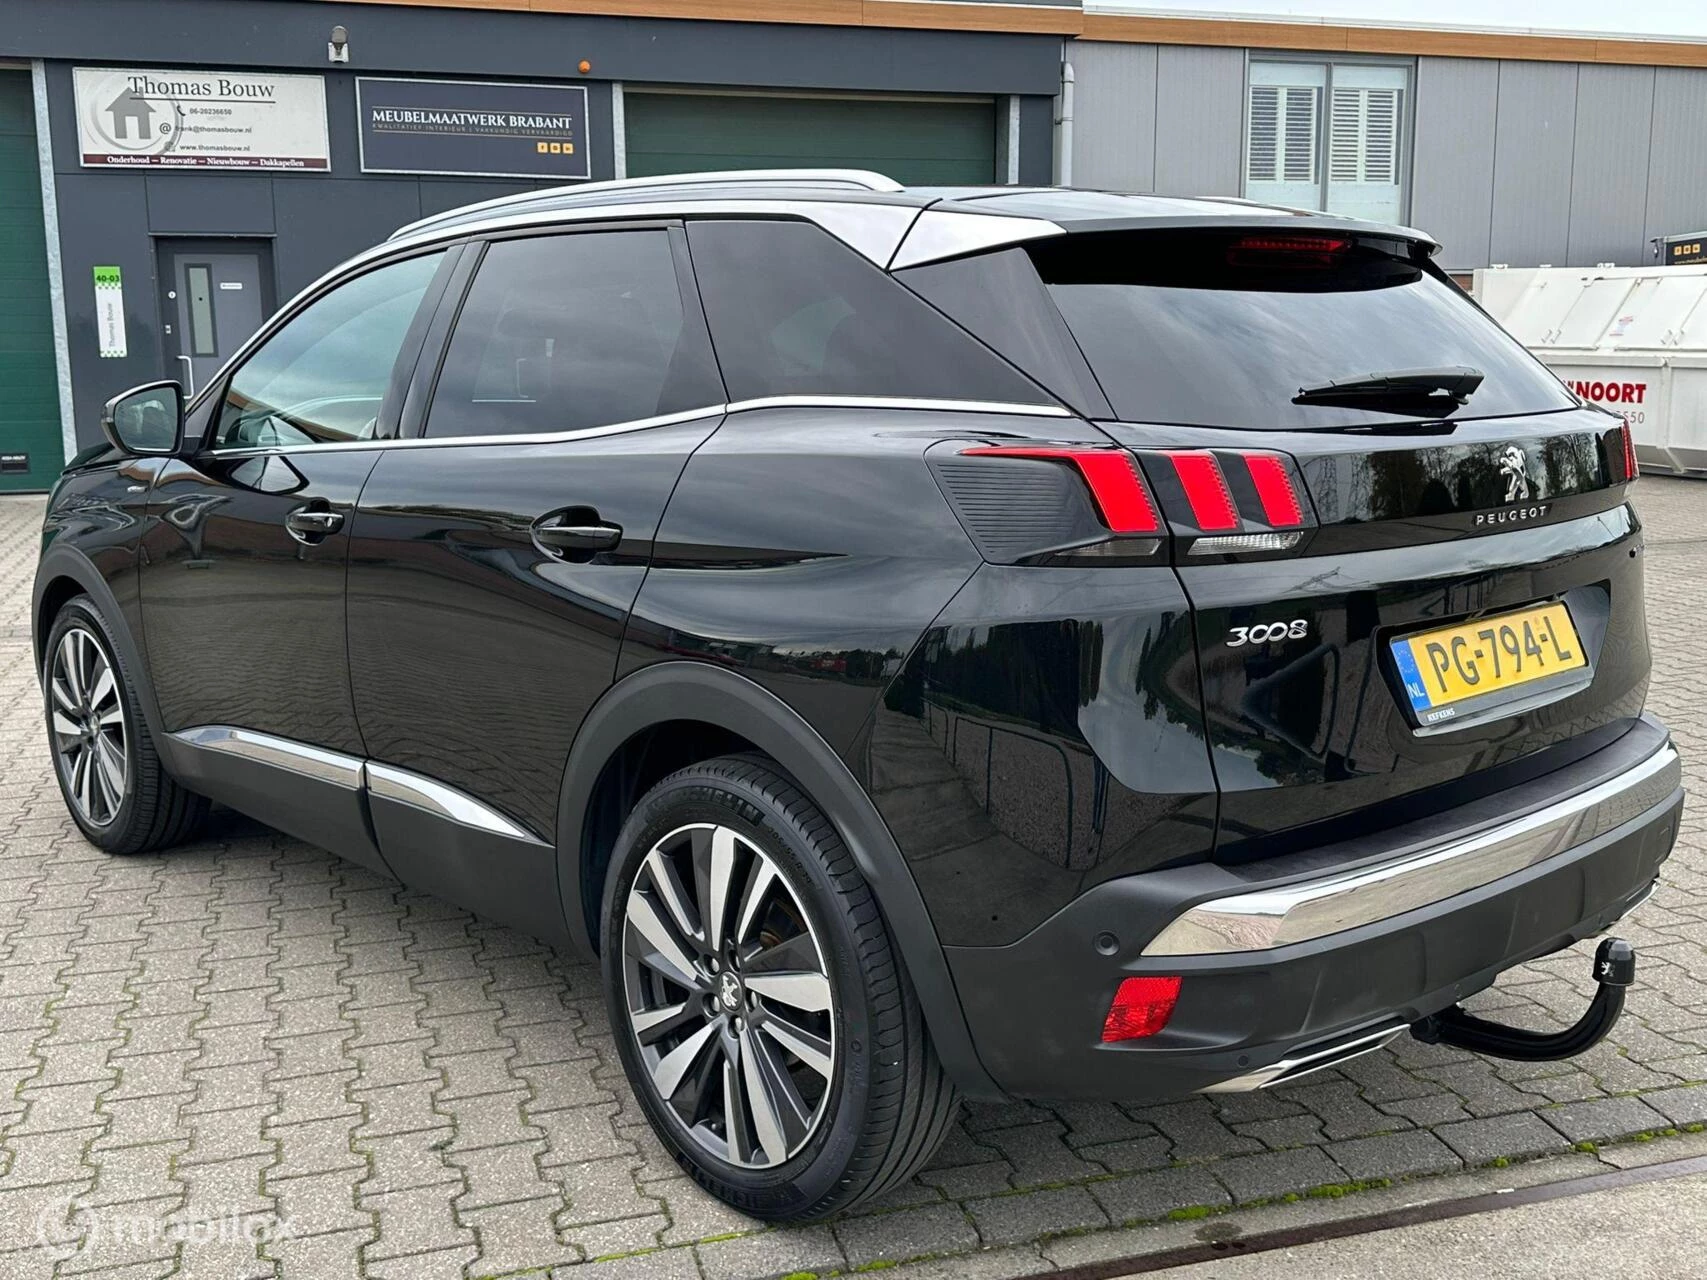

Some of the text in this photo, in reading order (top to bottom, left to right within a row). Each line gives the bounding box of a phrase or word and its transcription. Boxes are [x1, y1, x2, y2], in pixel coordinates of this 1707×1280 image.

[128, 76, 275, 98] Thomas Bouw
[372, 110, 572, 129] MEUBELMAATWERK BRABANT
[180, 144, 250, 152] www.thomasbouw.nl
[107, 155, 304, 168] Onderhoud Renovatie Nieuwbouw Dakkapellen
[96, 274, 120, 282] 40-03
[1576, 381, 1647, 404] NOORT
[1475, 505, 1548, 526] PEUGEOT
[1225, 619, 1309, 648] 3008
[1426, 615, 1572, 693] PG-794-L
[1407, 680, 1426, 699] NL
